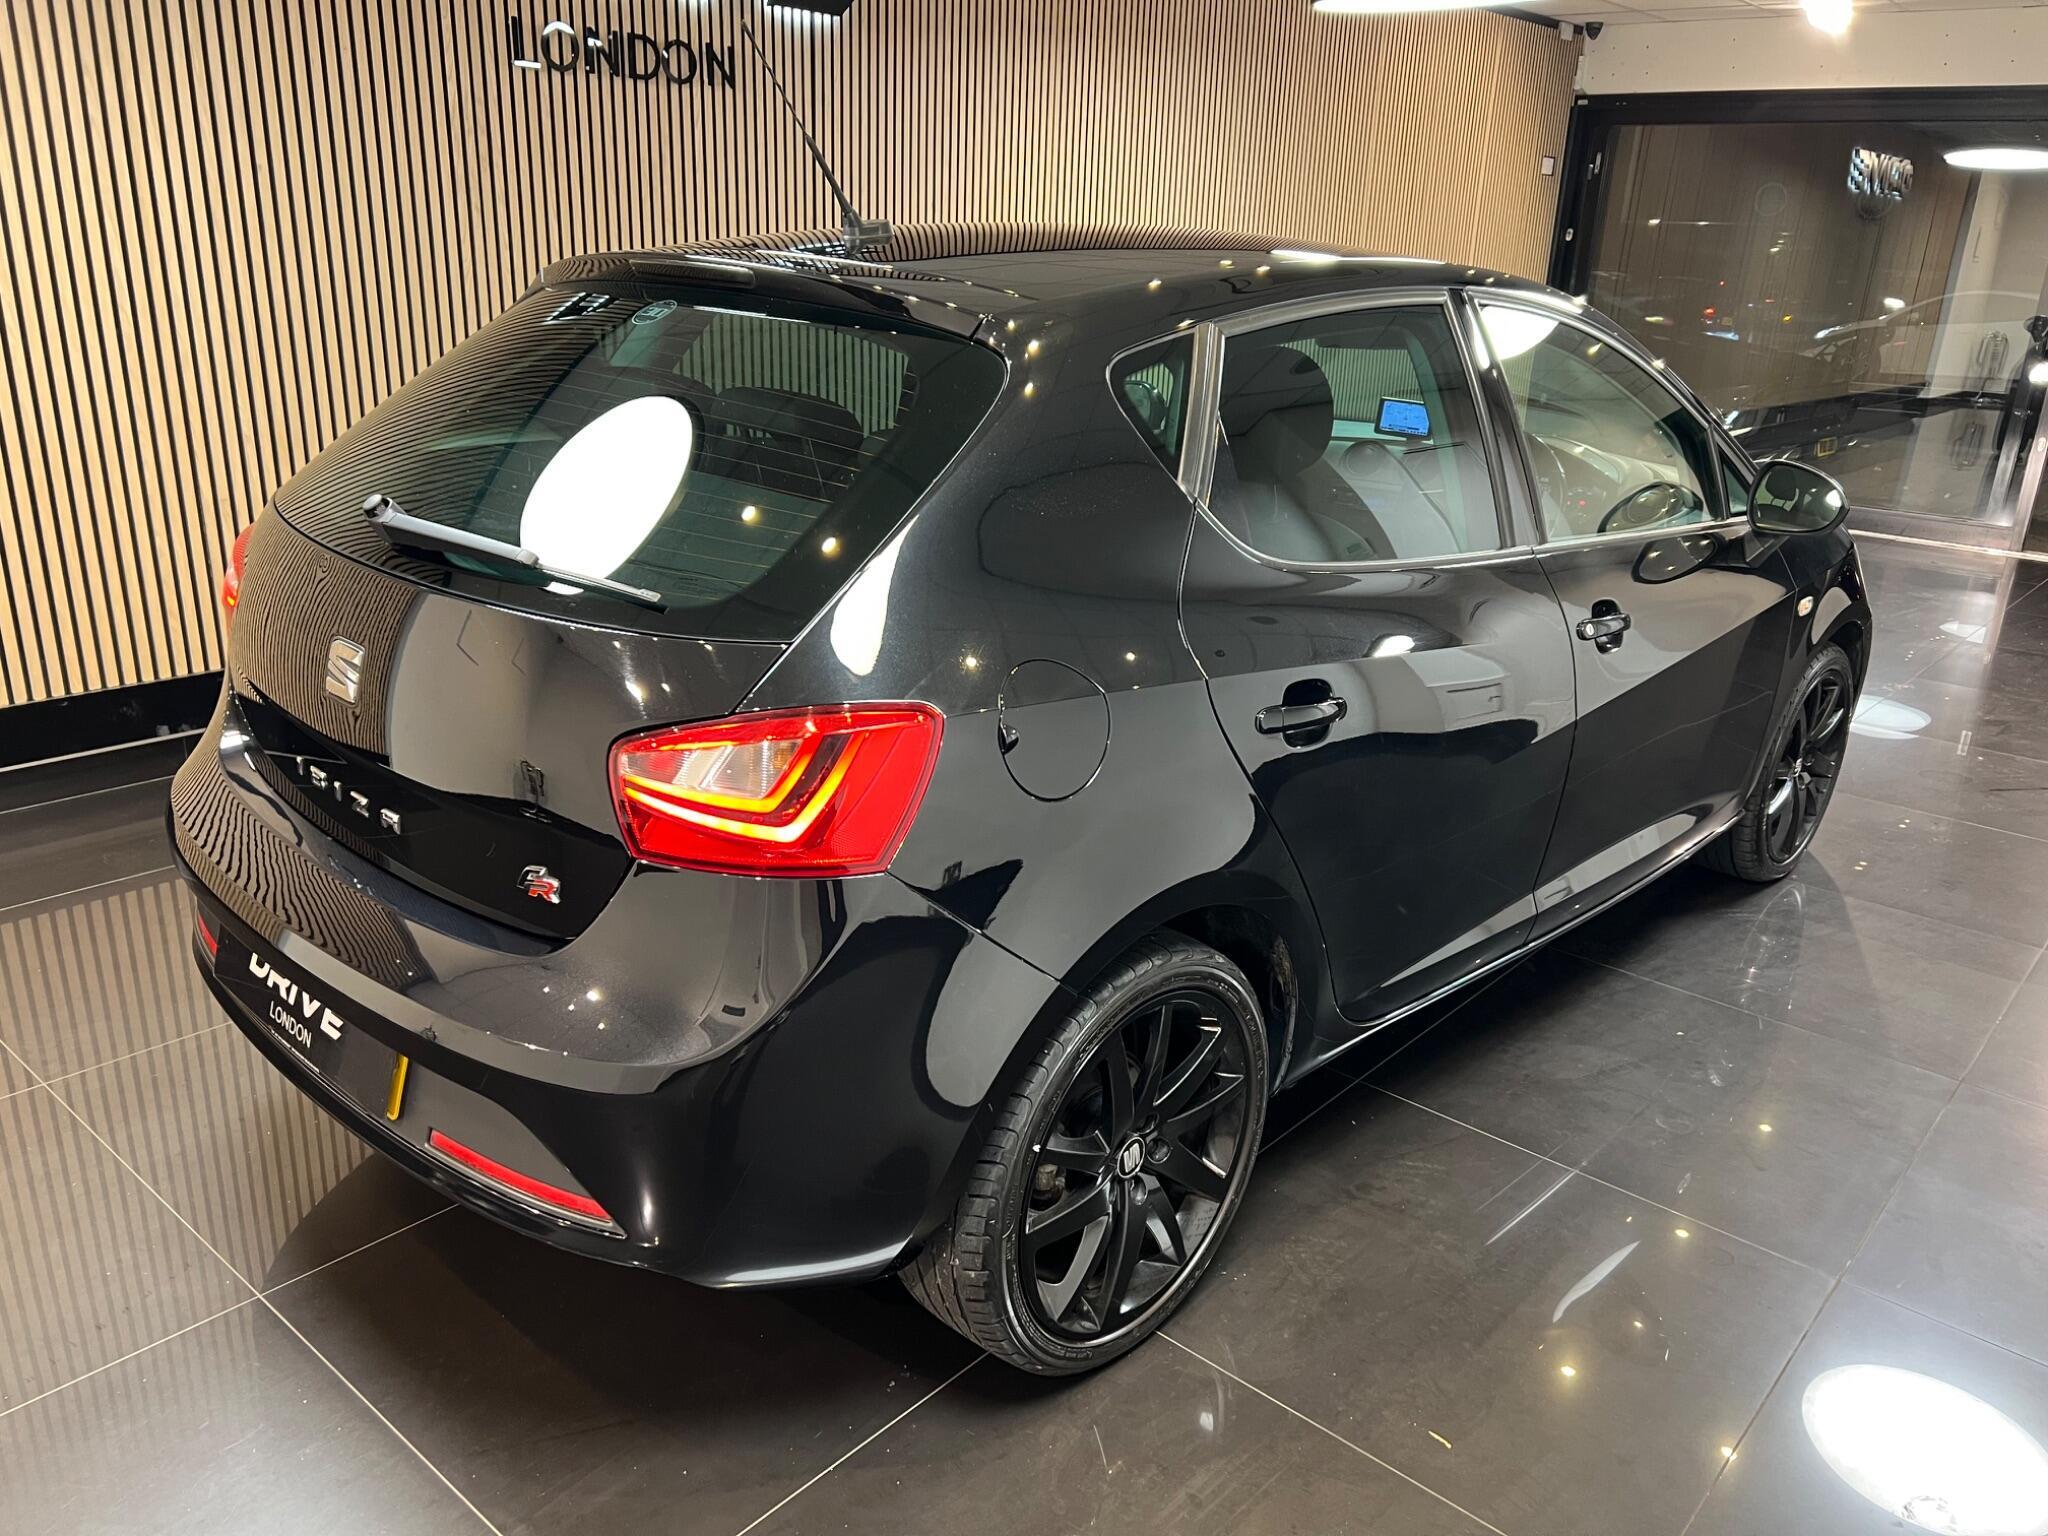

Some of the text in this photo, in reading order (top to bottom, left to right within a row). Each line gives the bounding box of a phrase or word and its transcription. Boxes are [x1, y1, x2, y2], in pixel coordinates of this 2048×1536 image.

[508, 15, 736, 90] LONDON
[296, 756, 401, 835] IBIZA
[269, 1000, 312, 1049] LONDON
